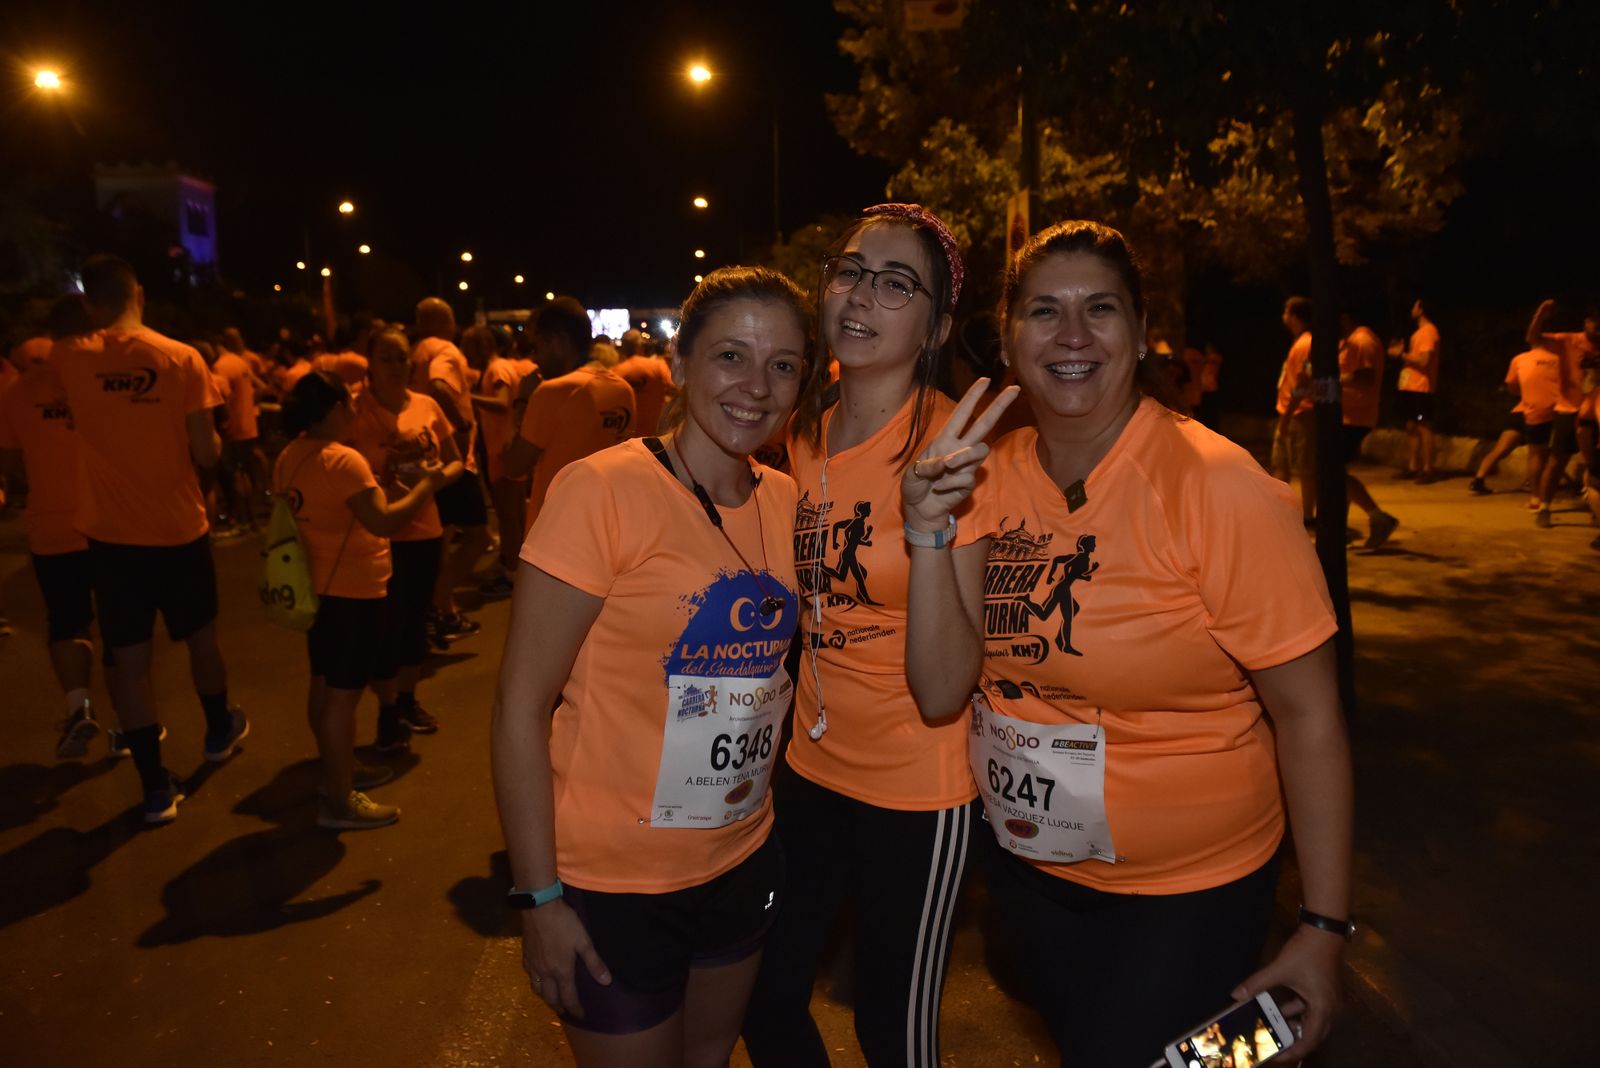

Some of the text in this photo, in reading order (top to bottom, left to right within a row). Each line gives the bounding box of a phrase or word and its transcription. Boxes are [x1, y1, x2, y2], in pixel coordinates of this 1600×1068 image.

[847, 624, 881, 638] nationale
[849, 629, 897, 645] nederlanden
[680, 643, 709, 661] LA
[681, 660, 706, 675] del
[711, 723, 773, 771] 6348
[988, 758, 1056, 812] 6247
[1002, 803, 1045, 825] VAZQUEZ
[1047, 818, 1085, 832] LUQUE
